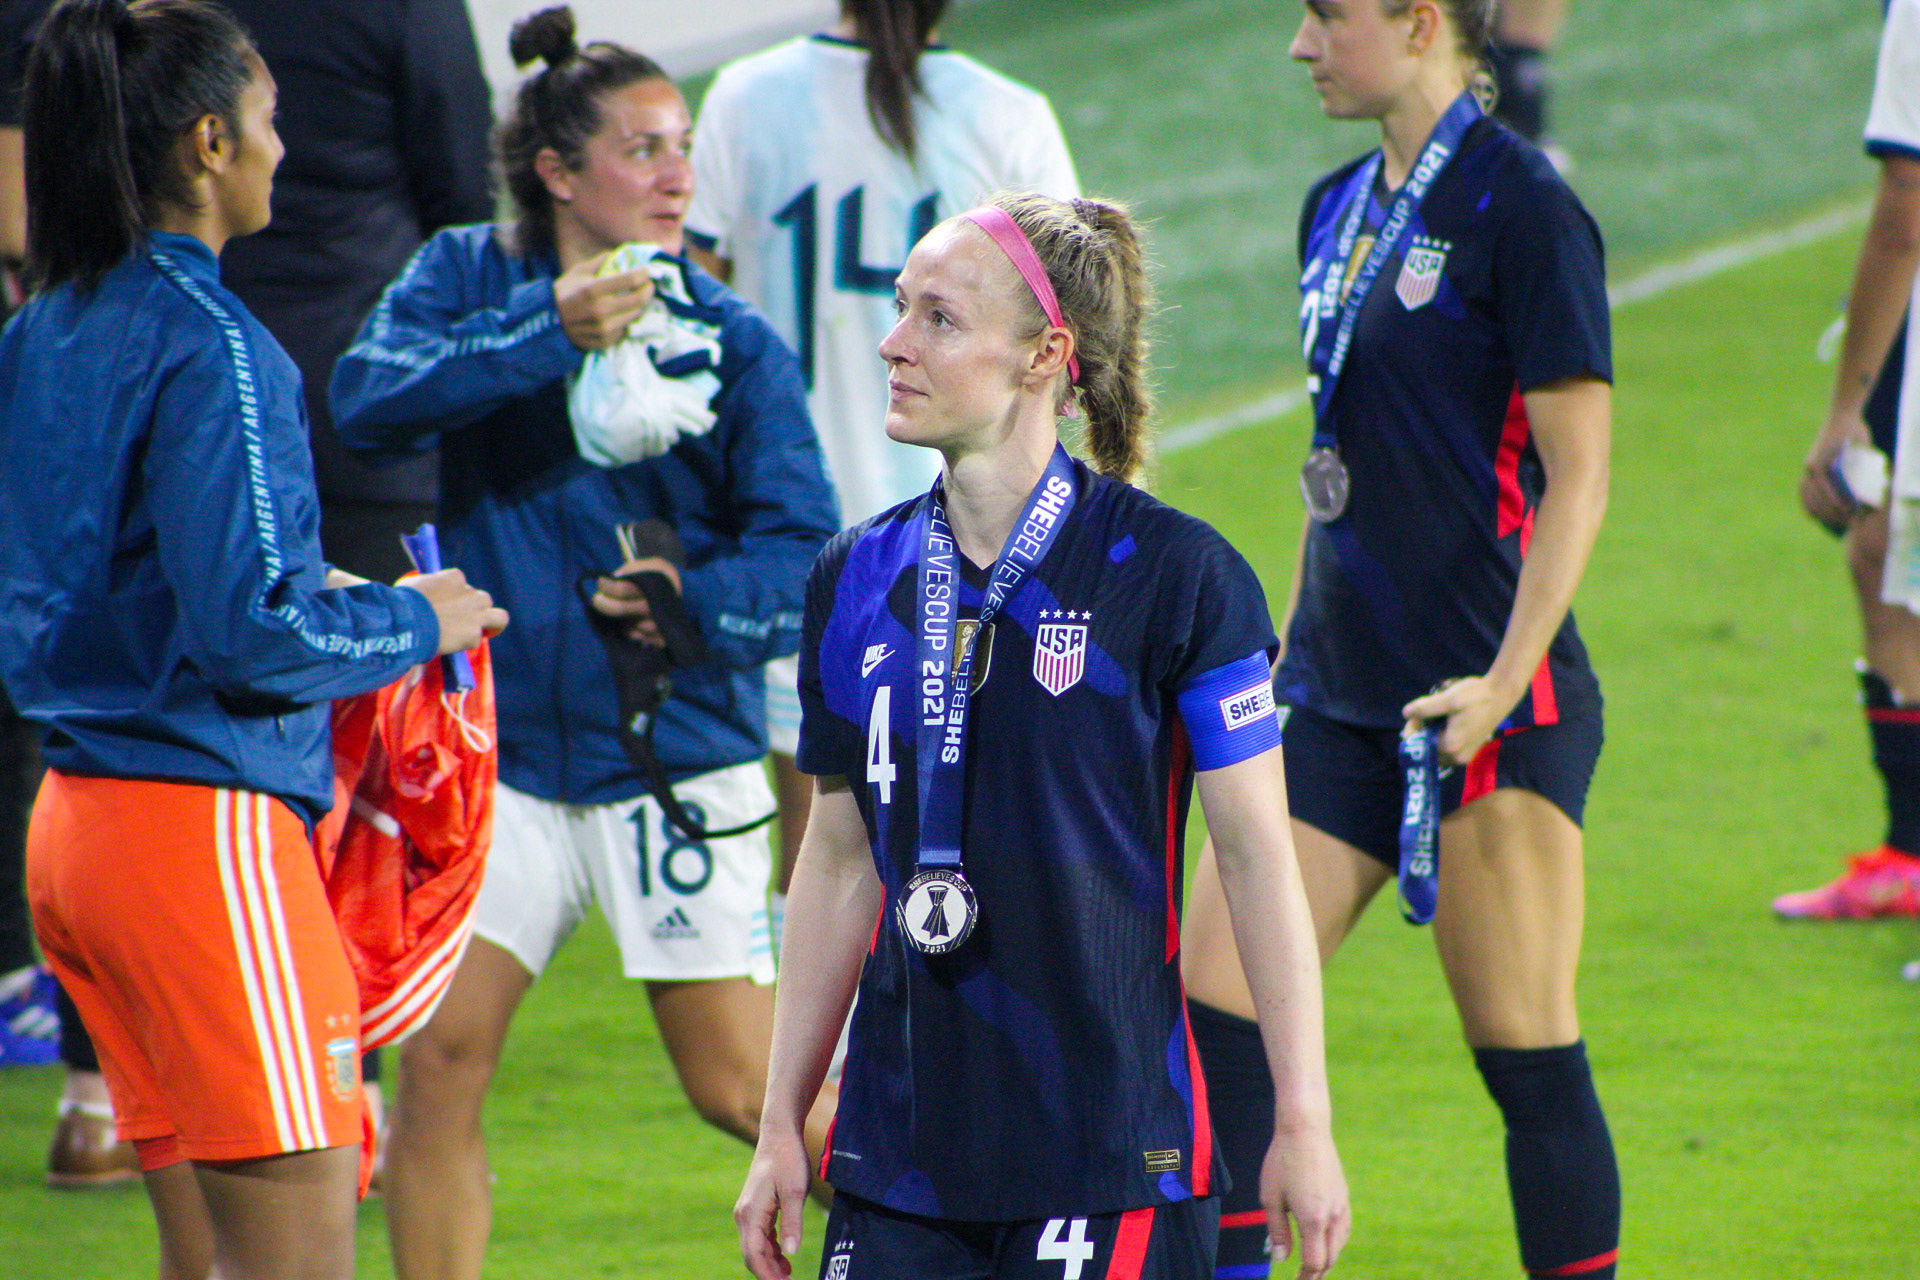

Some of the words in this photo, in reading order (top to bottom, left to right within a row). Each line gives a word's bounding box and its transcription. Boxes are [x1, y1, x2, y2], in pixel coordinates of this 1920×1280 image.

[1405, 142, 1450, 199] 2021
[1407, 251, 1443, 275] USA
[863, 643, 888, 665] NIKE
[1039, 626, 1084, 655] USA
[921, 660, 945, 726] 2021
[866, 685, 897, 804] 4
[1405, 766, 1427, 825] 2021
[626, 800, 714, 897] 18
[1036, 1217, 1095, 1280] 4
